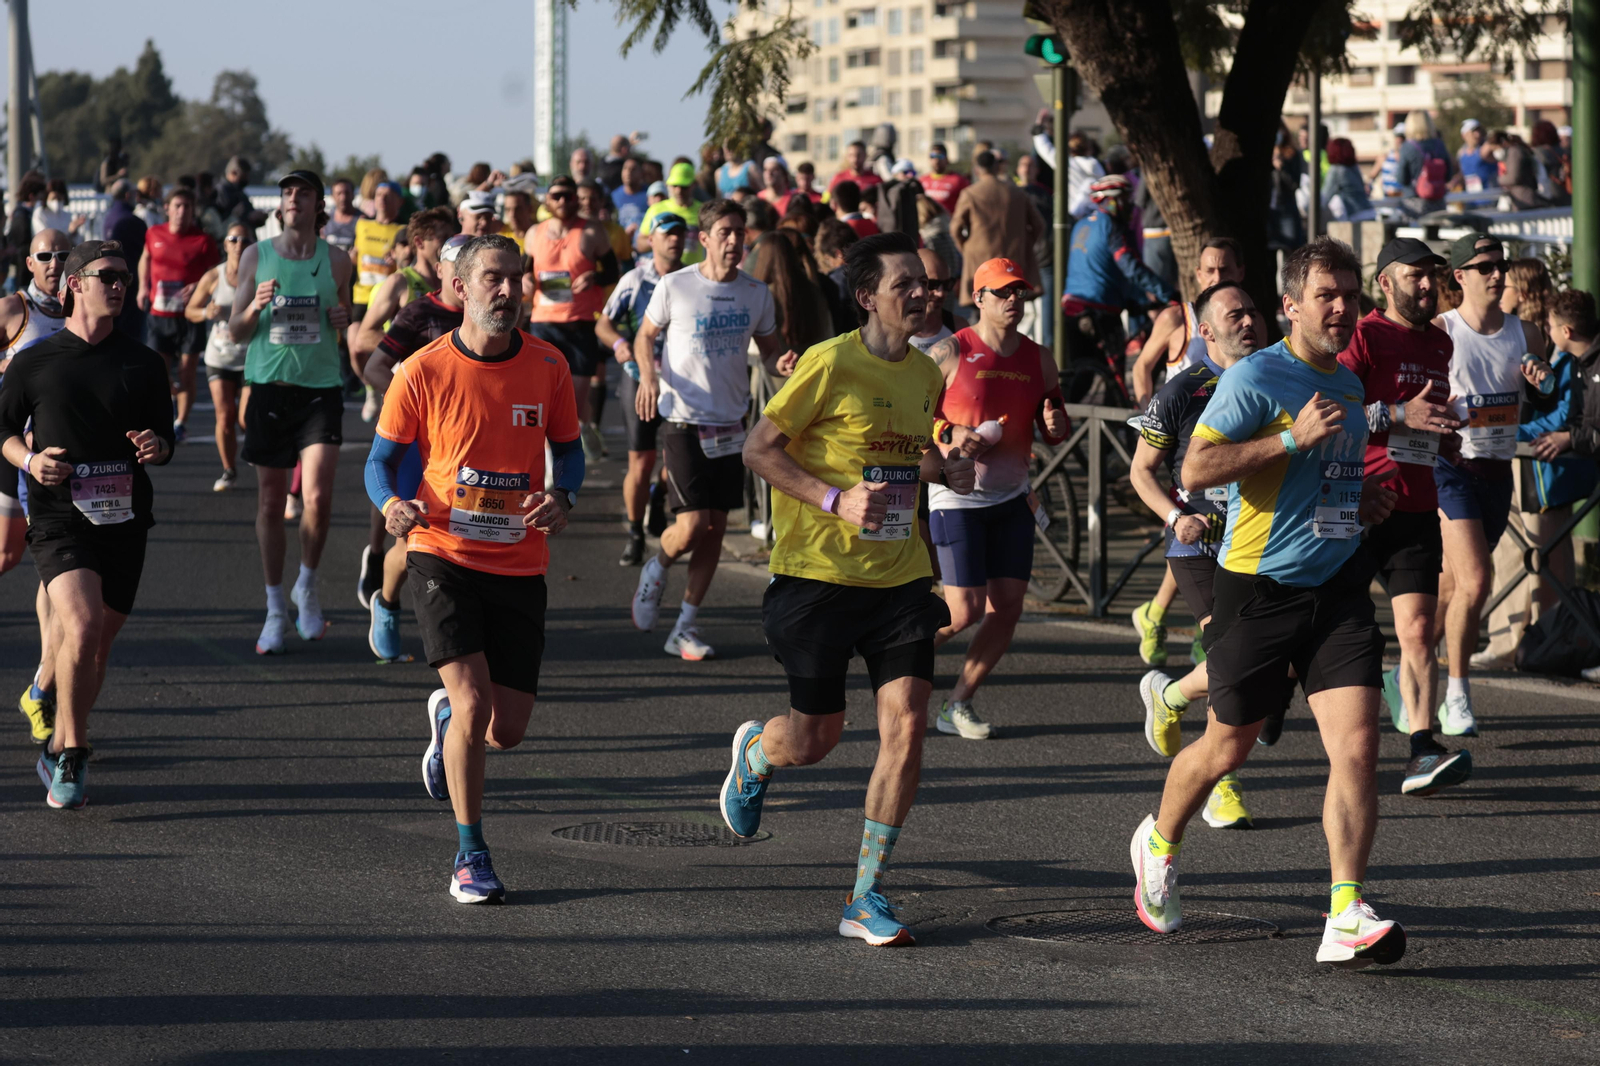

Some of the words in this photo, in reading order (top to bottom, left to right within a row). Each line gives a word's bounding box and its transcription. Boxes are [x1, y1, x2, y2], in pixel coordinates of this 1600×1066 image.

[287, 297, 316, 306] ZURICH
[696, 313, 751, 331] MADRID
[975, 370, 1031, 382] ESPAÑA
[1486, 396, 1516, 405] ZURICH
[512, 403, 543, 427] nsl
[1409, 439, 1430, 450] CÉSAR
[92, 463, 127, 474] ZURICH
[1342, 467, 1364, 477] ZUR
[884, 470, 916, 480] ZURICH
[481, 475, 521, 487] ZURICH
[94, 484, 116, 495] 7425
[91, 500, 113, 509] MITCH
[478, 497, 505, 510] 3650
[885, 493, 902, 506] 211
[469, 513, 510, 526] JUANCDG
